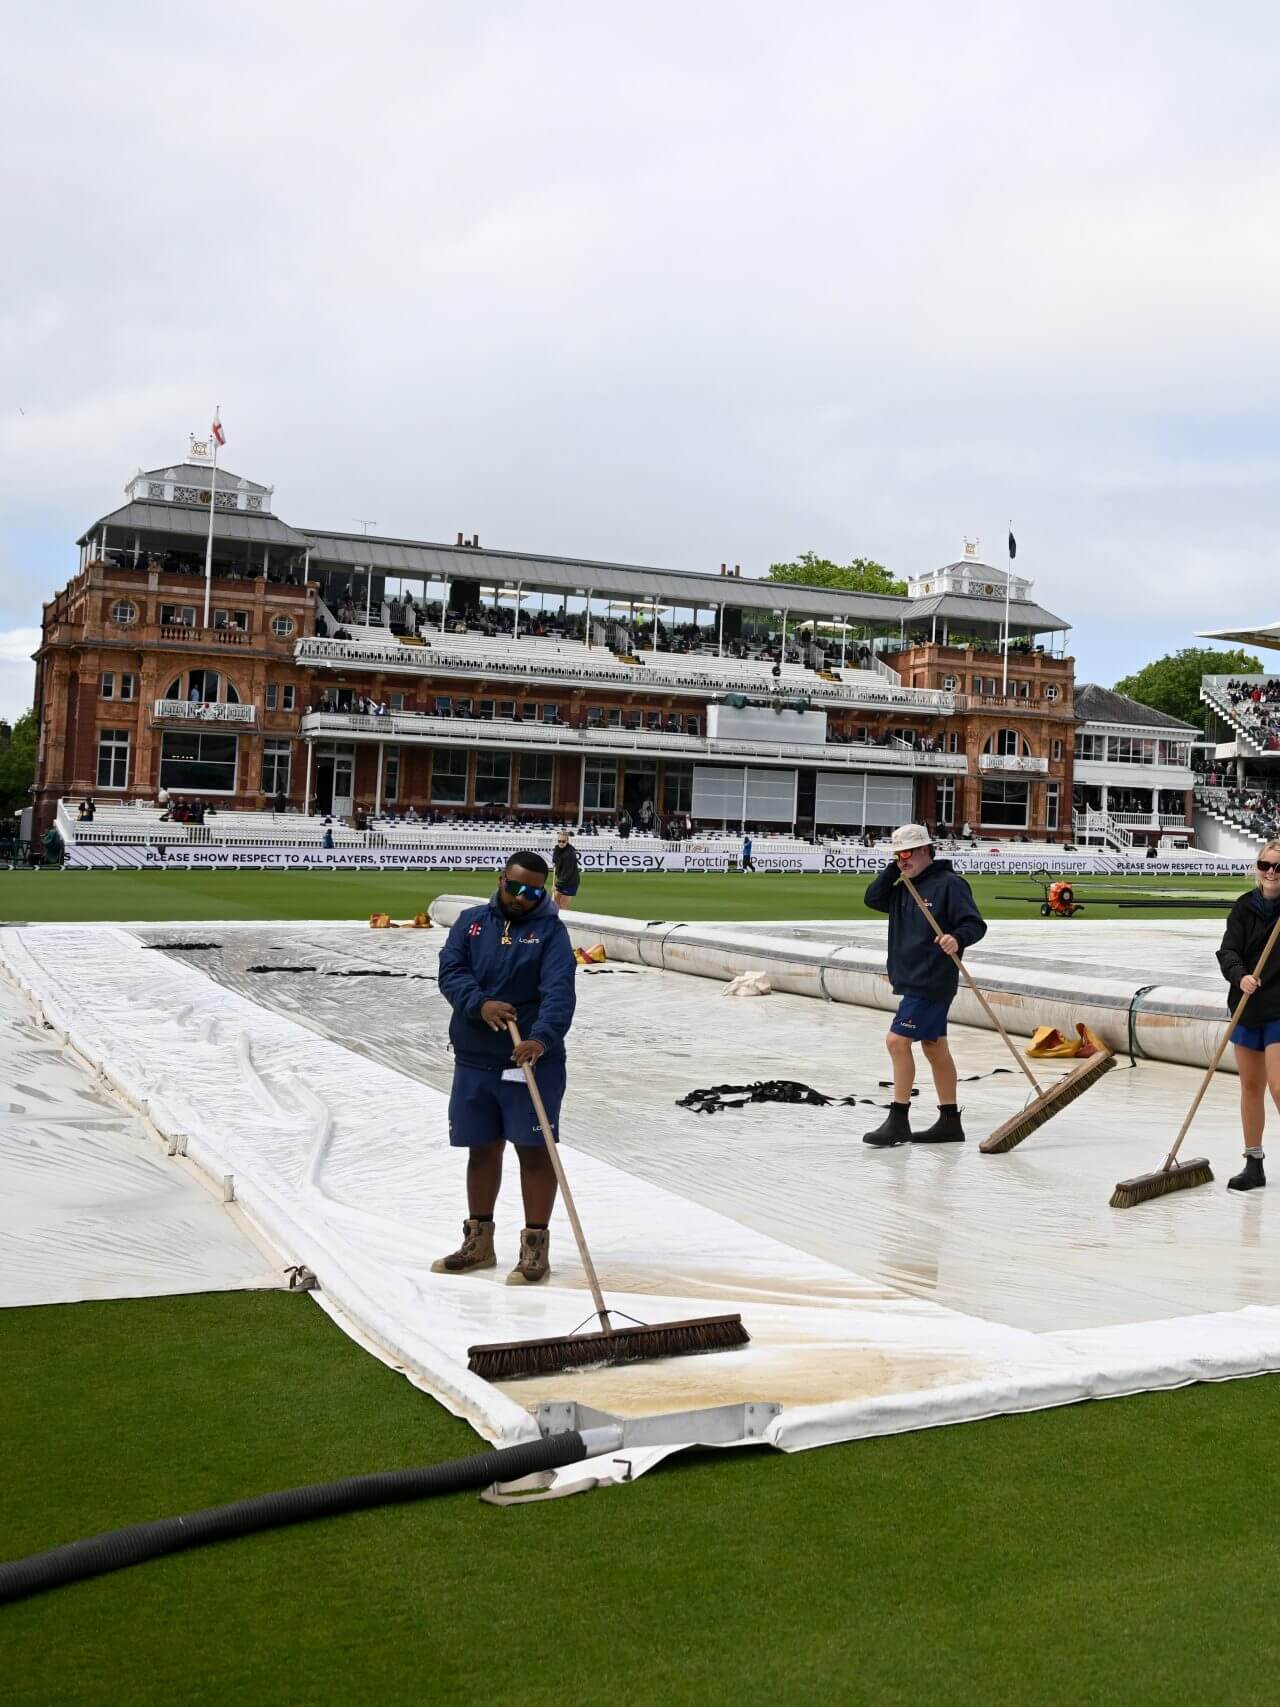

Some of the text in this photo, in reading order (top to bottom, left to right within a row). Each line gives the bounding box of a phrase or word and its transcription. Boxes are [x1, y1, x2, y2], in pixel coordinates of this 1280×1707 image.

[146, 852, 509, 866] PLEASE SHOW RESPECT TO ALL PLAYERS, STEWARDS AND SPECTAT
[751, 856, 802, 868] Pensions
[824, 854, 896, 869] Rothesa
[953, 856, 1087, 873] K's largest pension insurer
[1117, 862, 1146, 871] PLEASE
[1147, 862, 1169, 871] SHOW
[1171, 863, 1202, 872] RESPECT
[1204, 863, 1215, 872] TO
[1216, 864, 1230, 872] ALL
